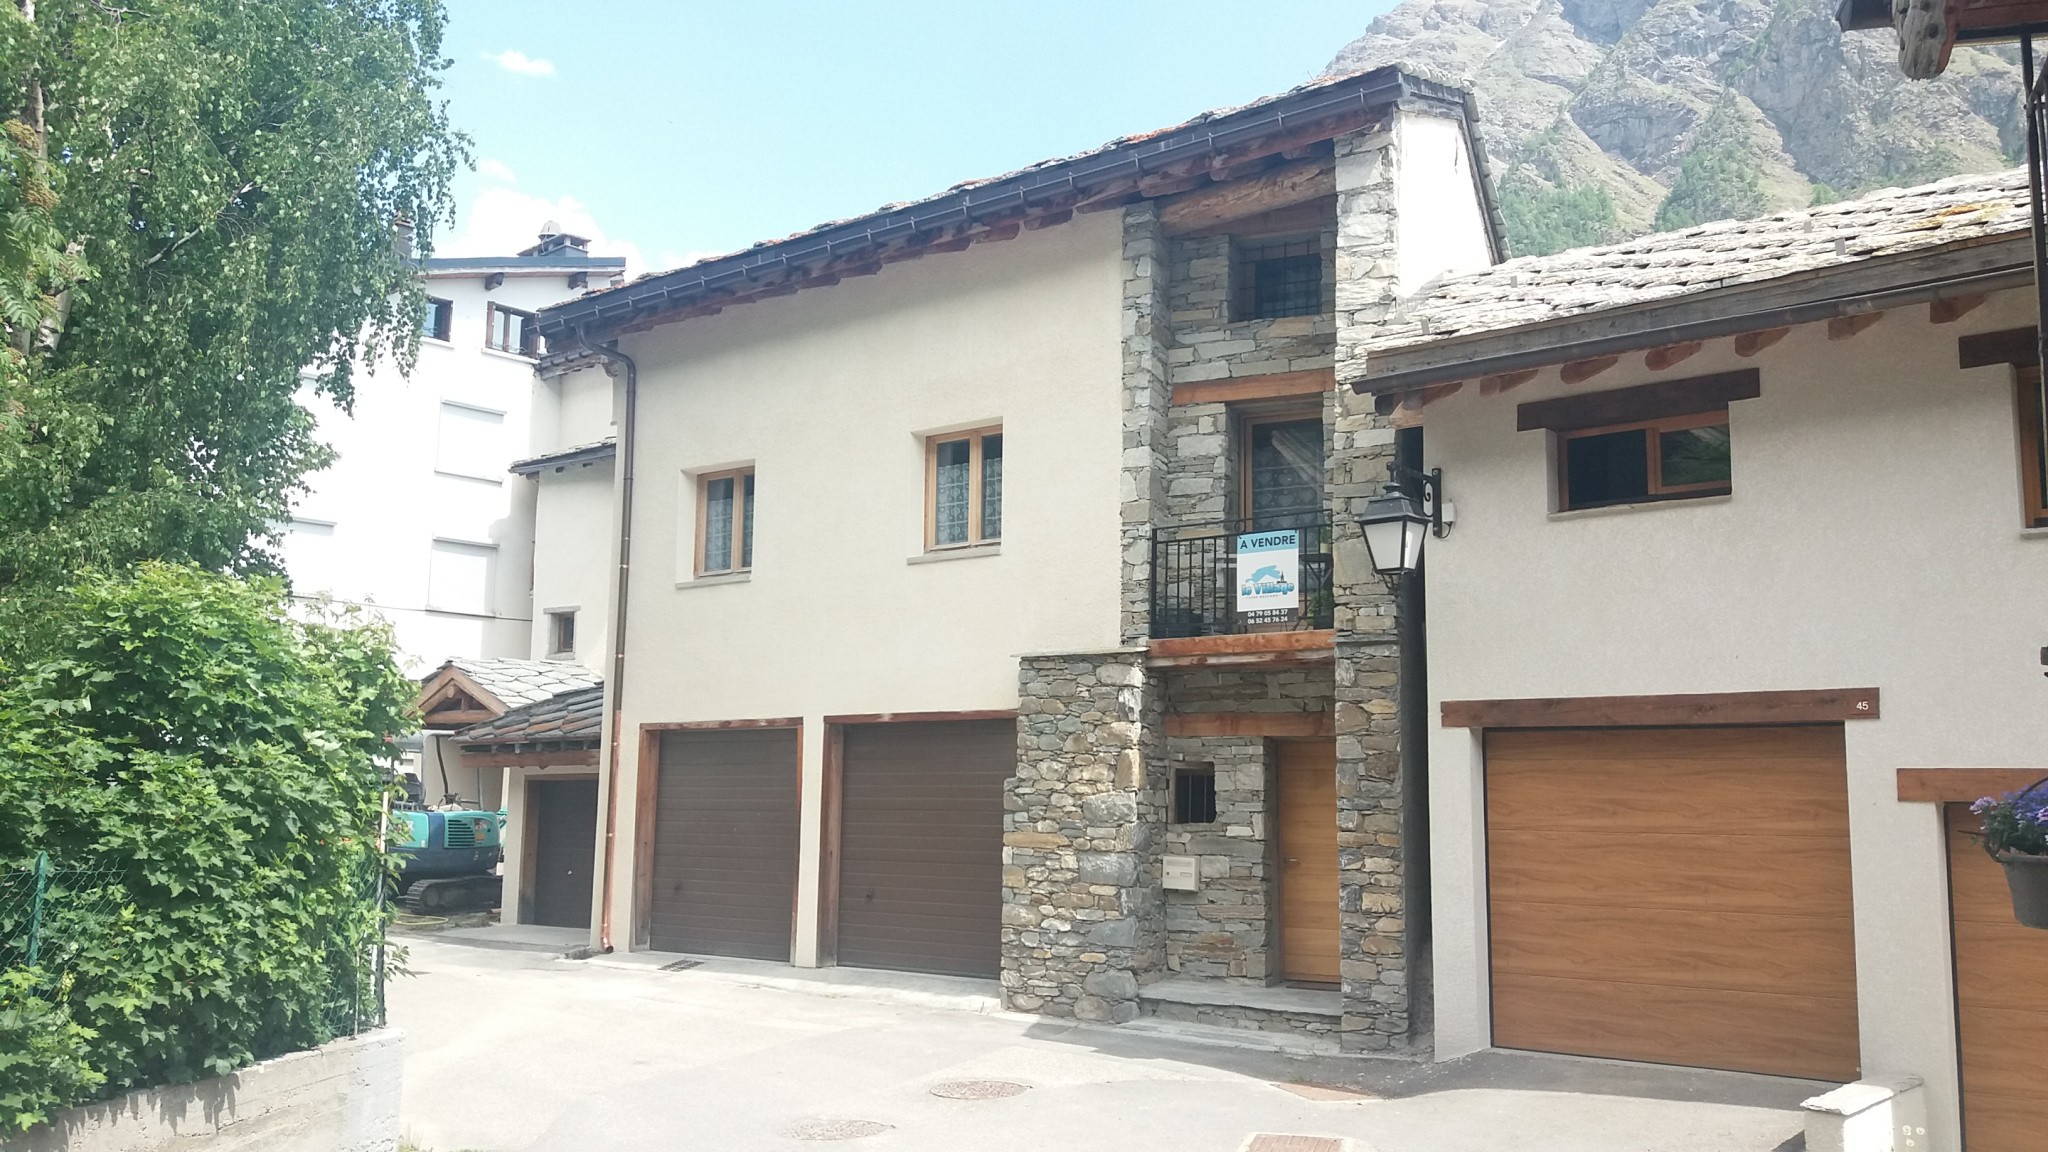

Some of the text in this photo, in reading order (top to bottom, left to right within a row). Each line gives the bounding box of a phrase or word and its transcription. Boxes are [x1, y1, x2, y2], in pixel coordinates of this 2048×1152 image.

[1251, 535, 1296, 548] VENDRE
[1241, 582, 1295, 596] le Village
[1856, 701, 1869, 711] 45
